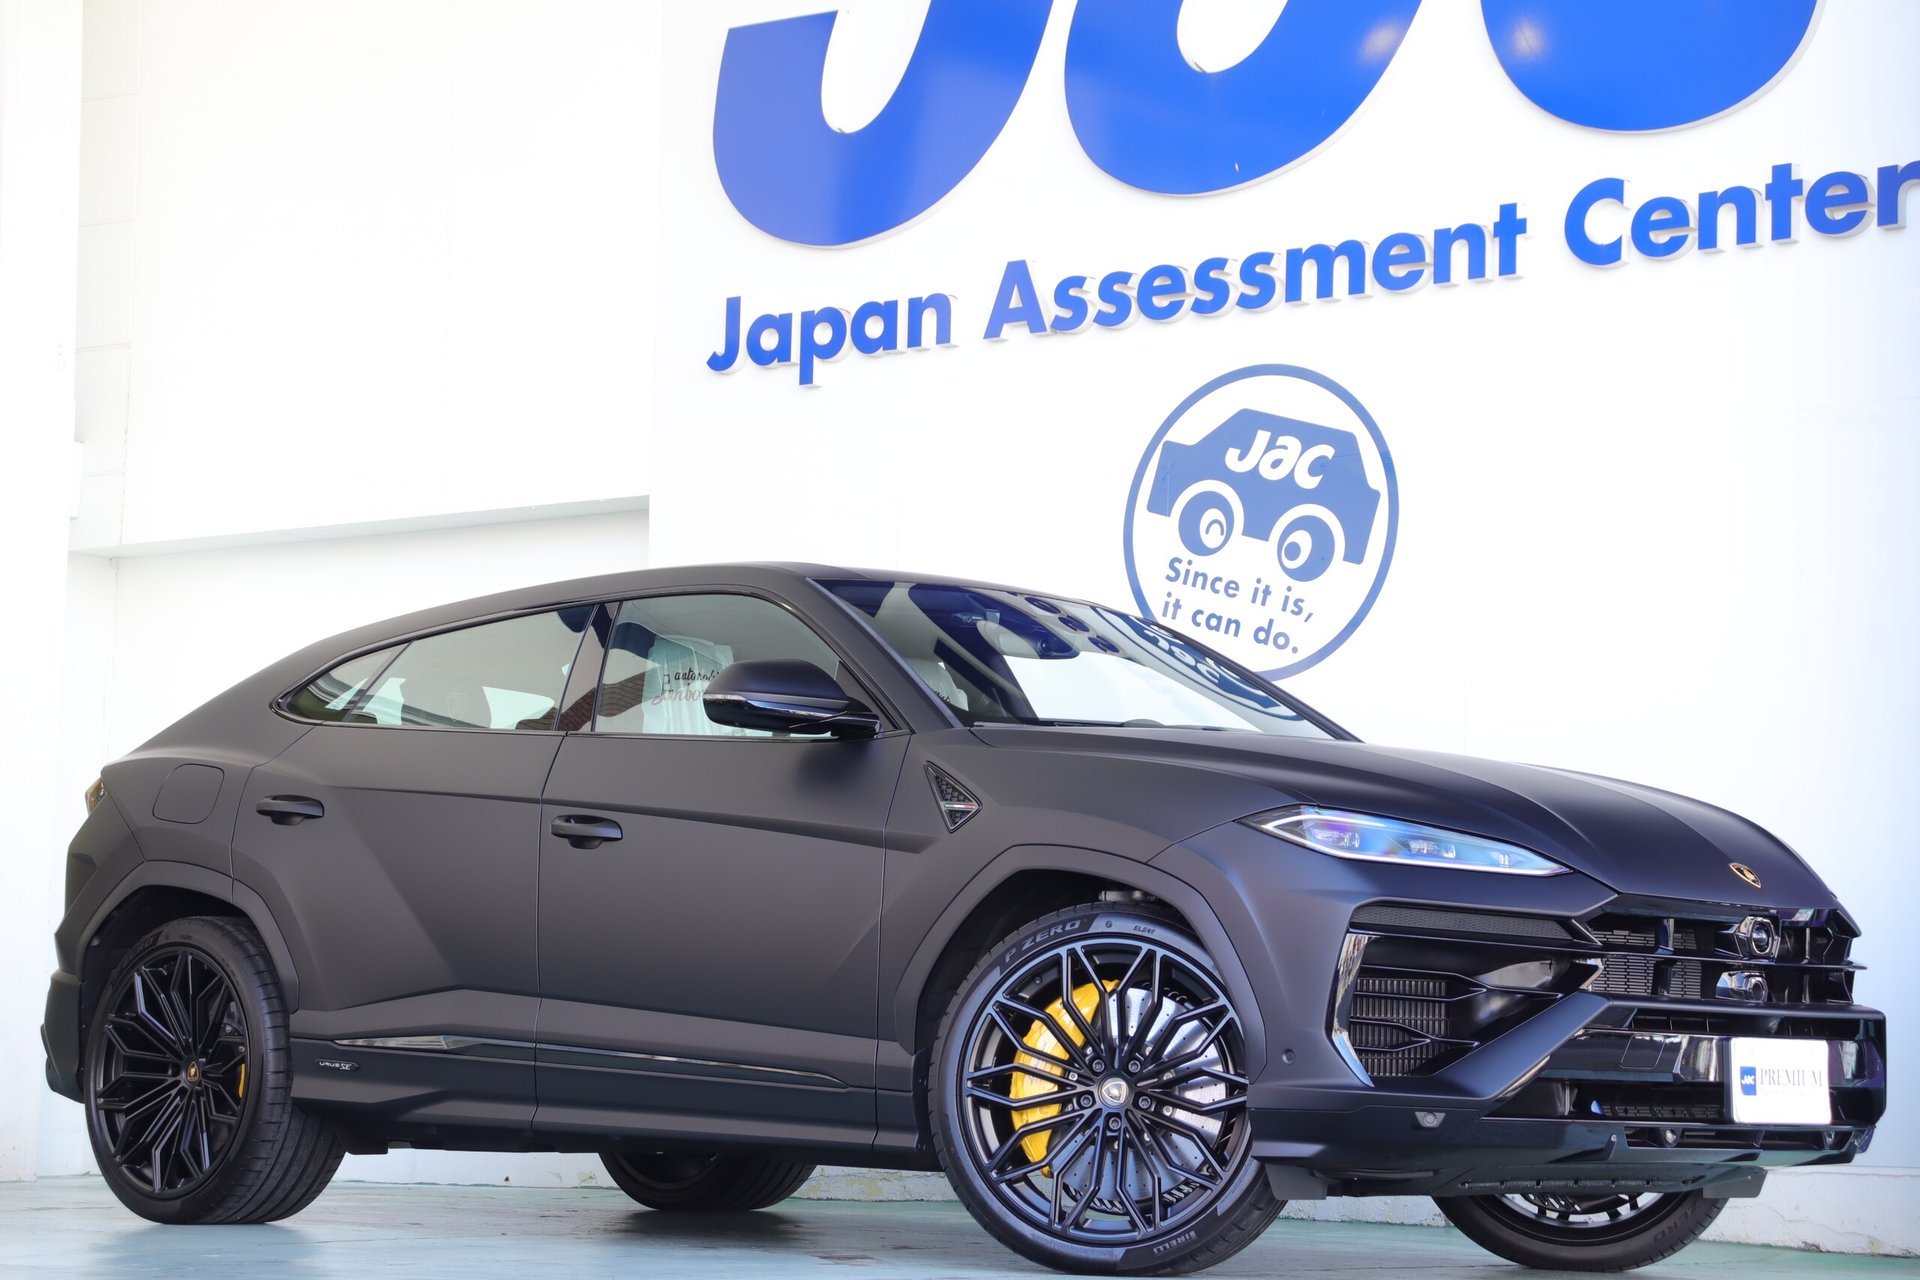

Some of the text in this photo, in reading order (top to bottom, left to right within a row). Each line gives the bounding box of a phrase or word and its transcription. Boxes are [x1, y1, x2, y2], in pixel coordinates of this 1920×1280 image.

[706, 160, 1920, 386] Japan Assessment Center
[1165, 556, 1314, 623] Since it is,
[1161, 591, 1299, 655] it can do.
[1005, 919, 1081, 963] P ZERO
[1760, 1067, 1823, 1087] PREMIUM
